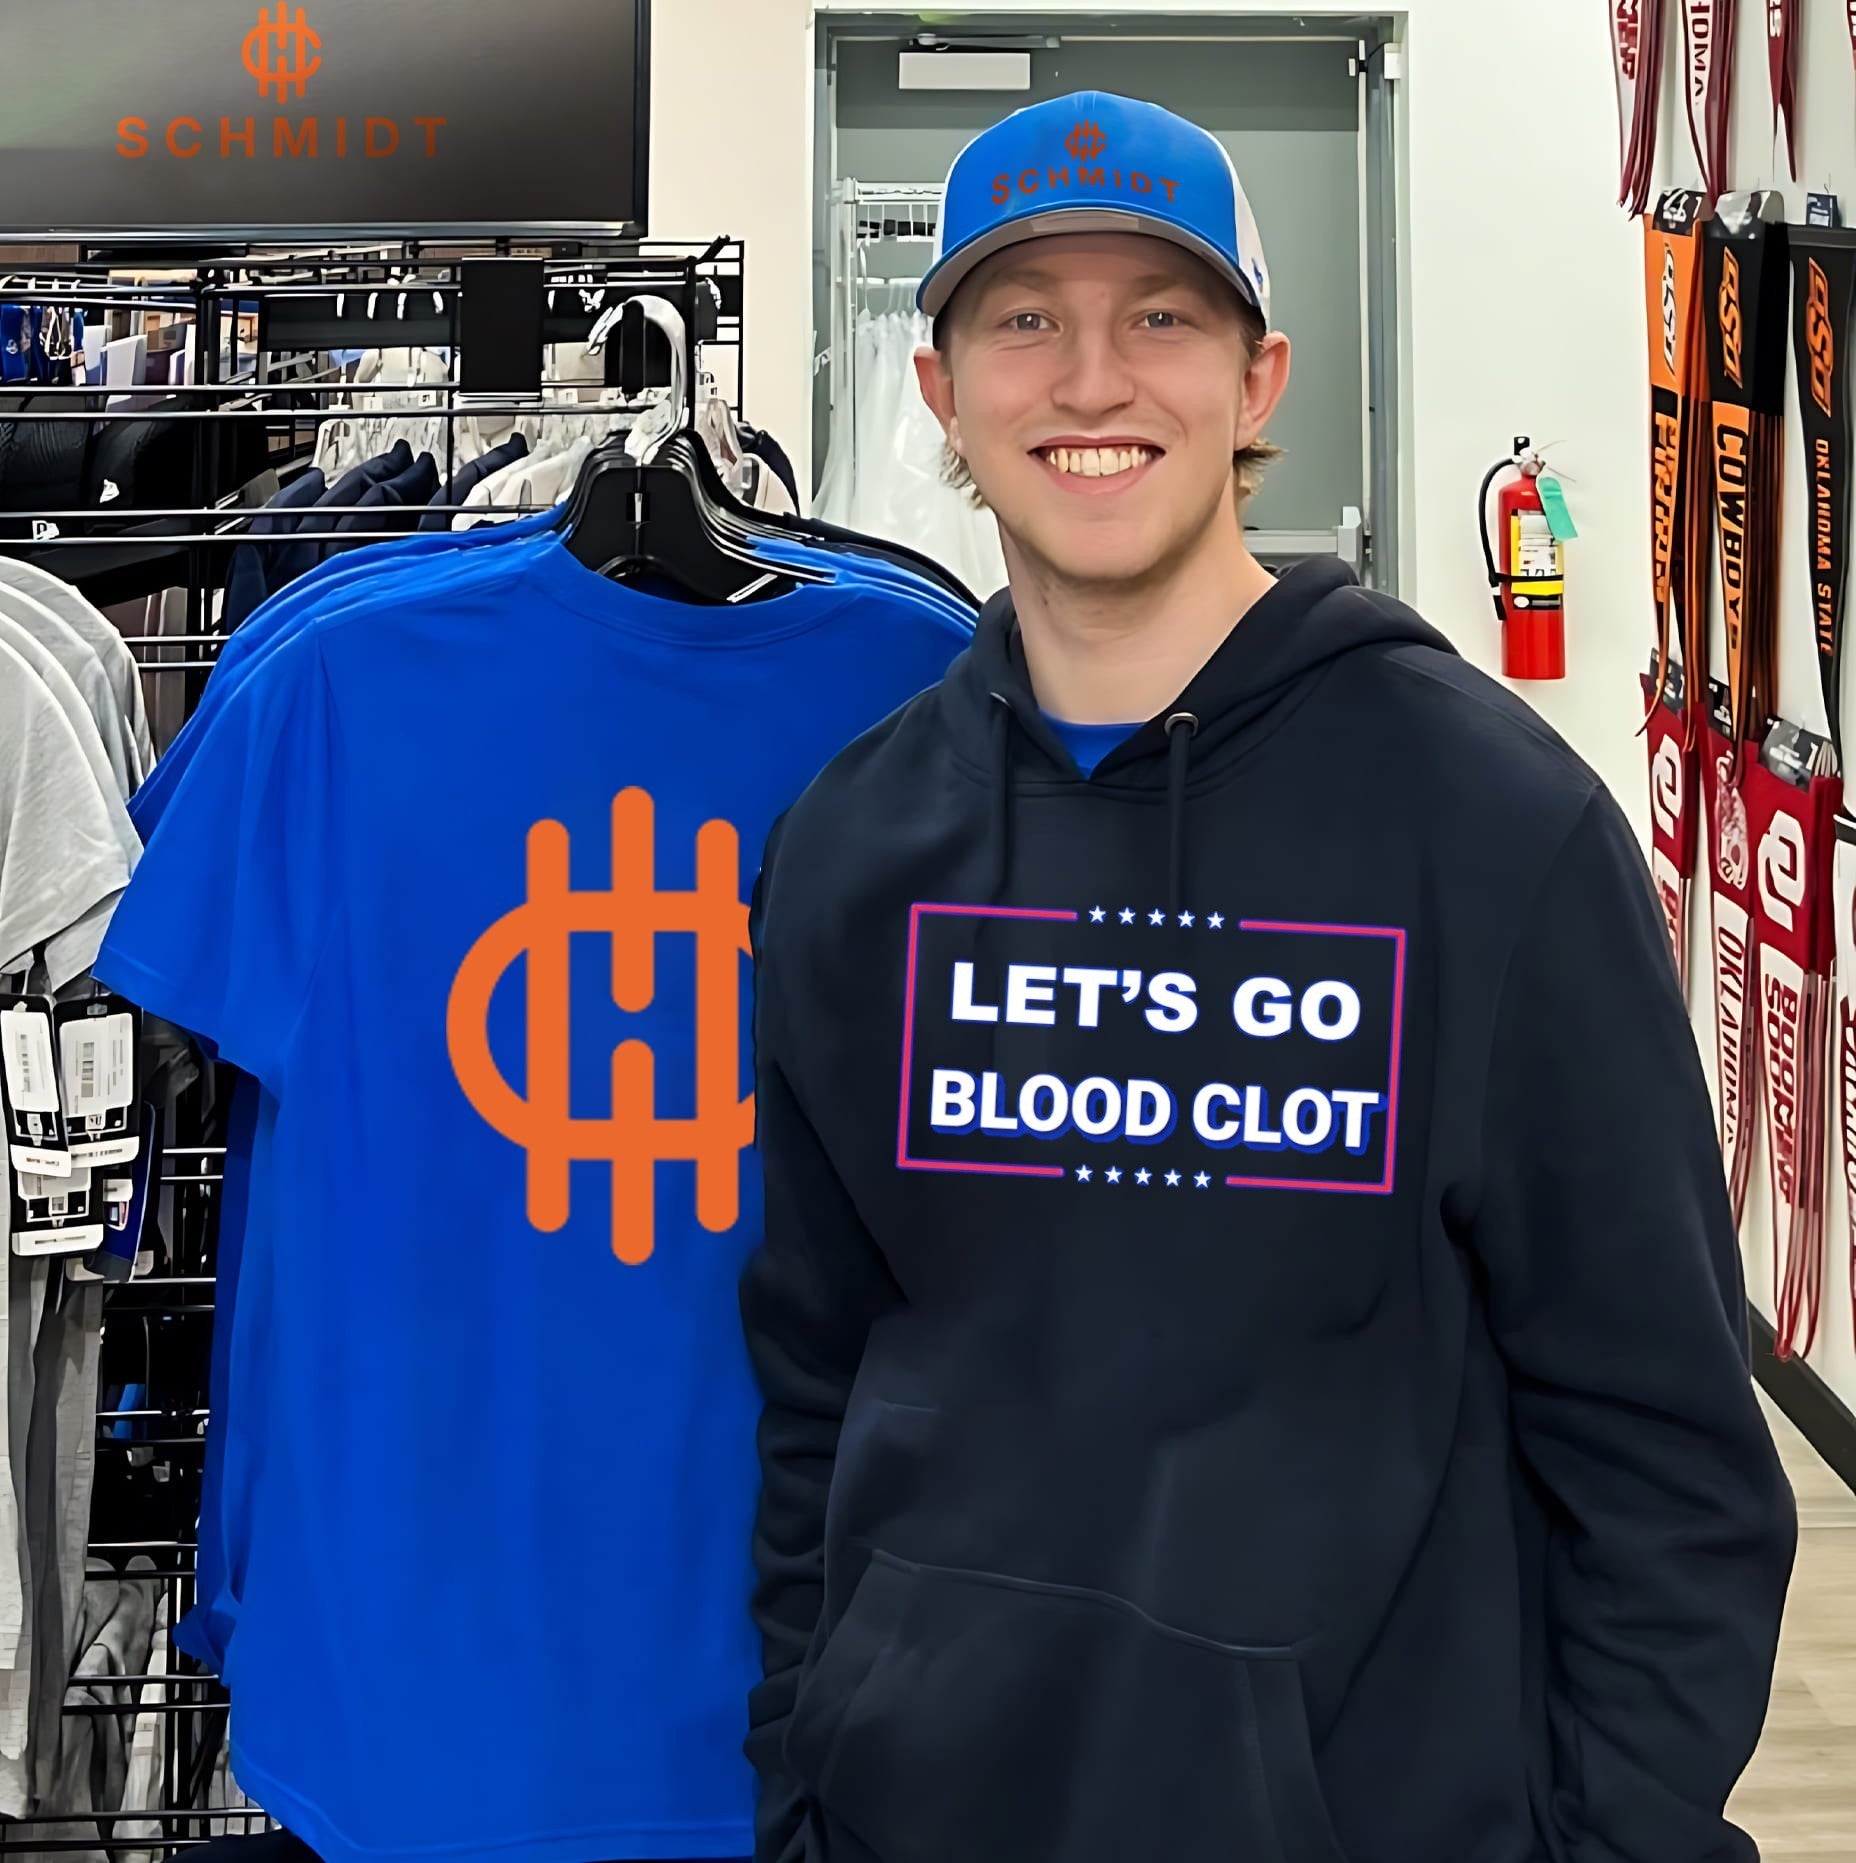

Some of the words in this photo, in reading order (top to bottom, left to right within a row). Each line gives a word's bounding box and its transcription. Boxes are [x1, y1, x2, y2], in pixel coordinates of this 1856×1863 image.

[116, 117, 447, 159] SCHMIDT
[991, 167, 1179, 204] SCHMIDT
[1815, 438, 1832, 570] OKLAHOMA
[1232, 976, 1361, 1041] GO
[1718, 926, 1745, 1144] OKLAHOMA
[929, 1068, 1175, 1142] BLOOD
[1191, 1082, 1386, 1154] CLOT
